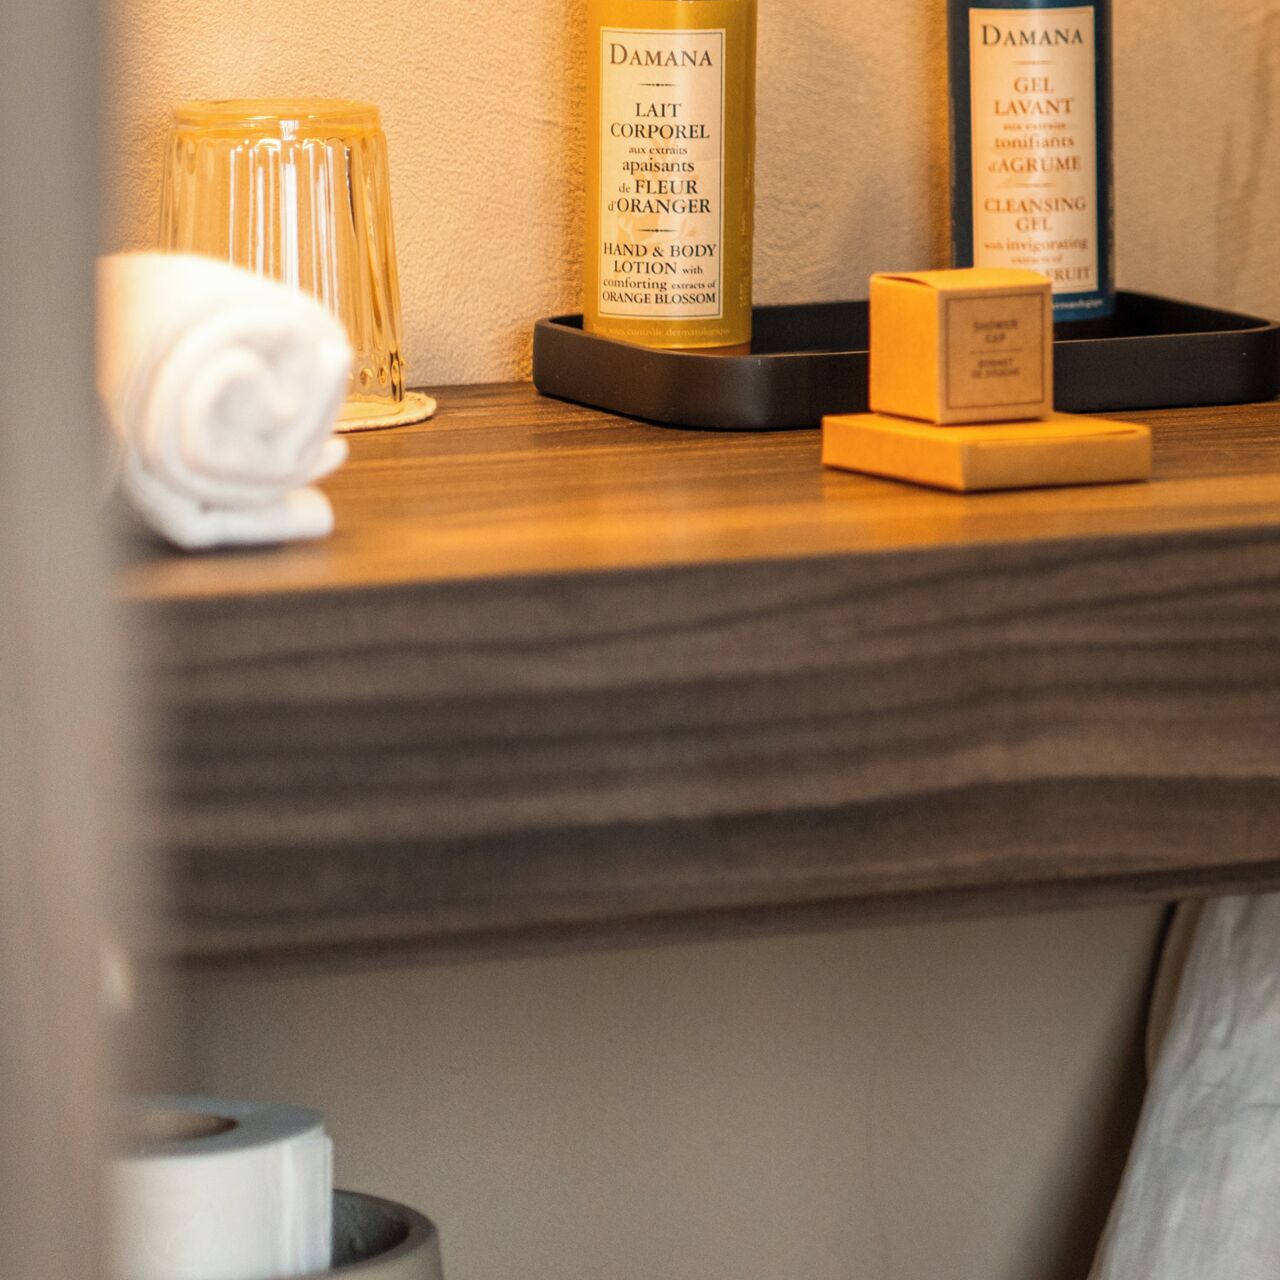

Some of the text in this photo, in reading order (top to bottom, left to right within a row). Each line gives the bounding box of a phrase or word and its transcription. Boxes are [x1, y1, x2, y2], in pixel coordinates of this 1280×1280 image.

[1013, 77, 1055, 94] GEL
[635, 102, 682, 118] LAIT
[994, 97, 1075, 116] LAVANT
[610, 122, 710, 139] CORPOREL
[628, 144, 688, 154] aux extraits
[995, 135, 1075, 150] tonifiants
[622, 157, 695, 175] apaisants
[618, 179, 698, 195] de FLEUR
[984, 196, 1086, 214] CLEANSING
[1016, 218, 1053, 232] GEL
[603, 242, 717, 258] HAND & BODY
[613, 260, 703, 275] LOTION with
[603, 276, 667, 292] comforting
[707, 280, 716, 289] of
[602, 290, 716, 305] ORANGE BLOSSOM
